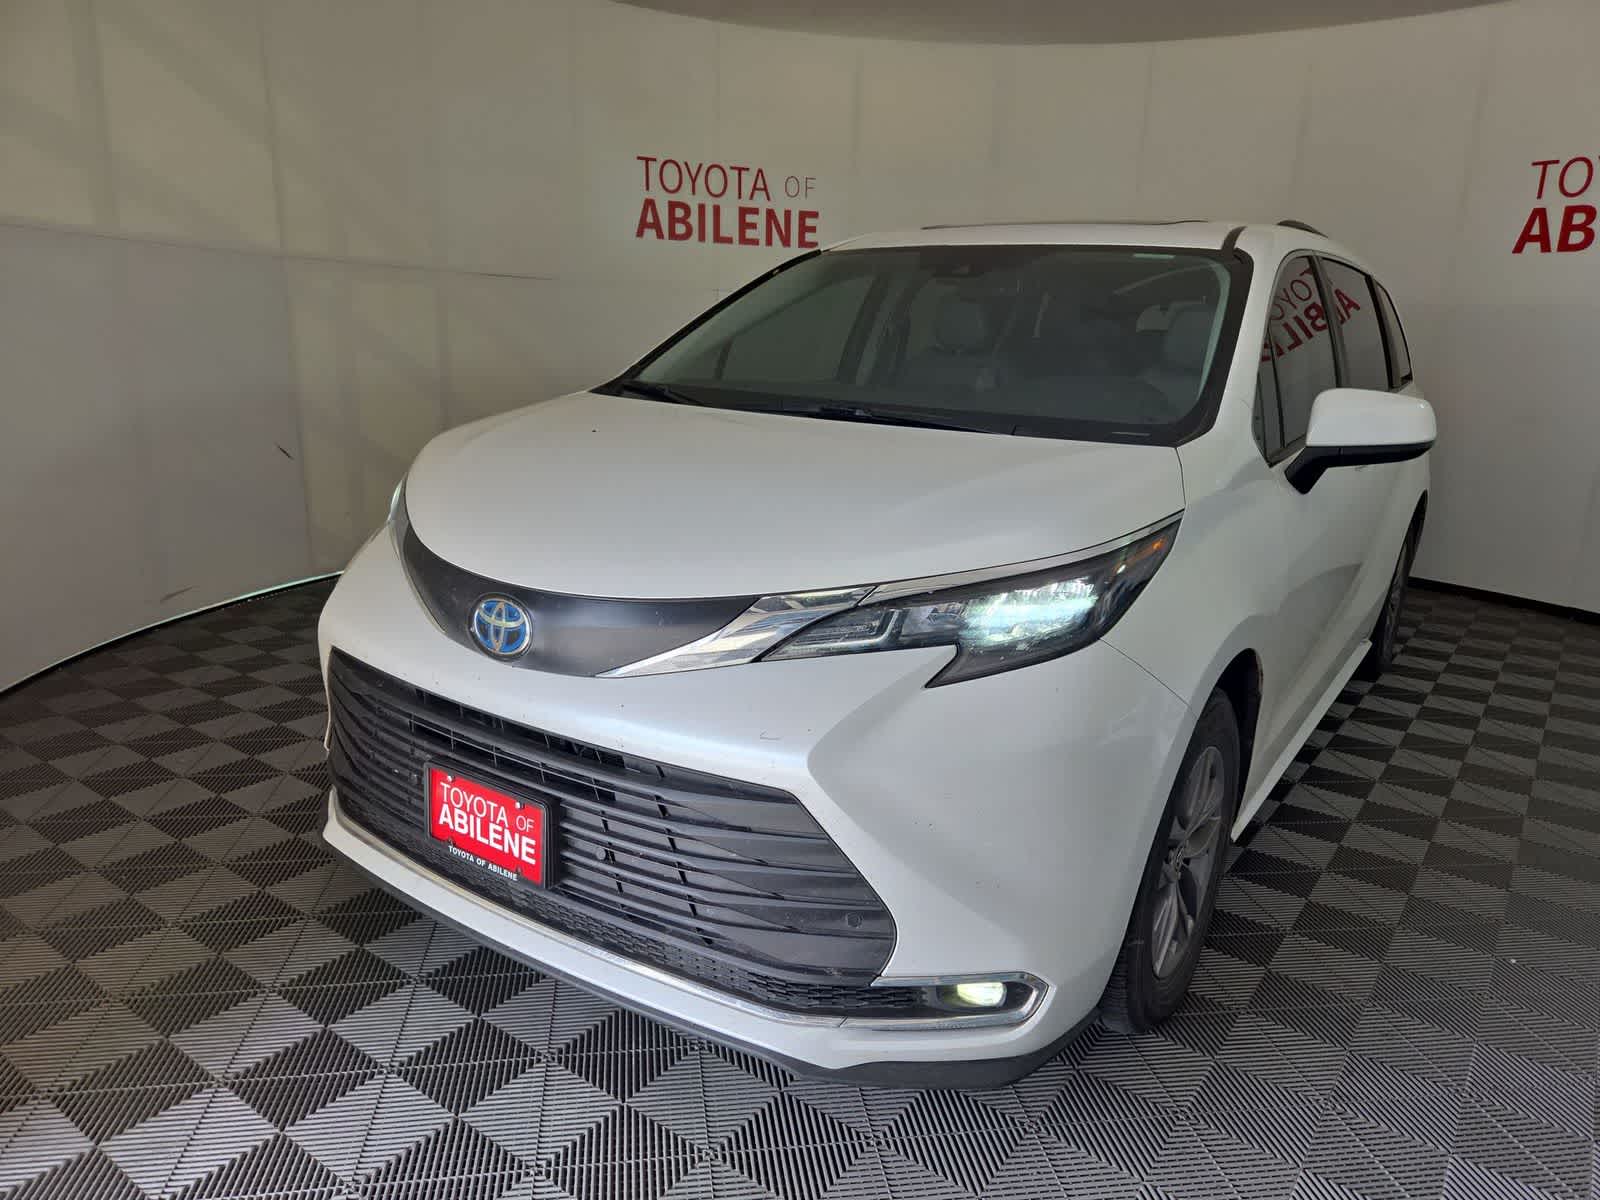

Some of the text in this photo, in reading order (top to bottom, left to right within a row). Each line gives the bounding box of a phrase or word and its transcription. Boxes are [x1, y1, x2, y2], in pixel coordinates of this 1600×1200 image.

[637, 156, 816, 201] TOYOTA OF
[1531, 156, 1600, 200] TO
[636, 198, 819, 249] ABILENE
[1512, 204, 1597, 254] AB
[440, 781, 535, 832] TOYOTA OF
[438, 803, 536, 865] ABILENE
[448, 845, 518, 881] TOYOTA OF ABILENE
